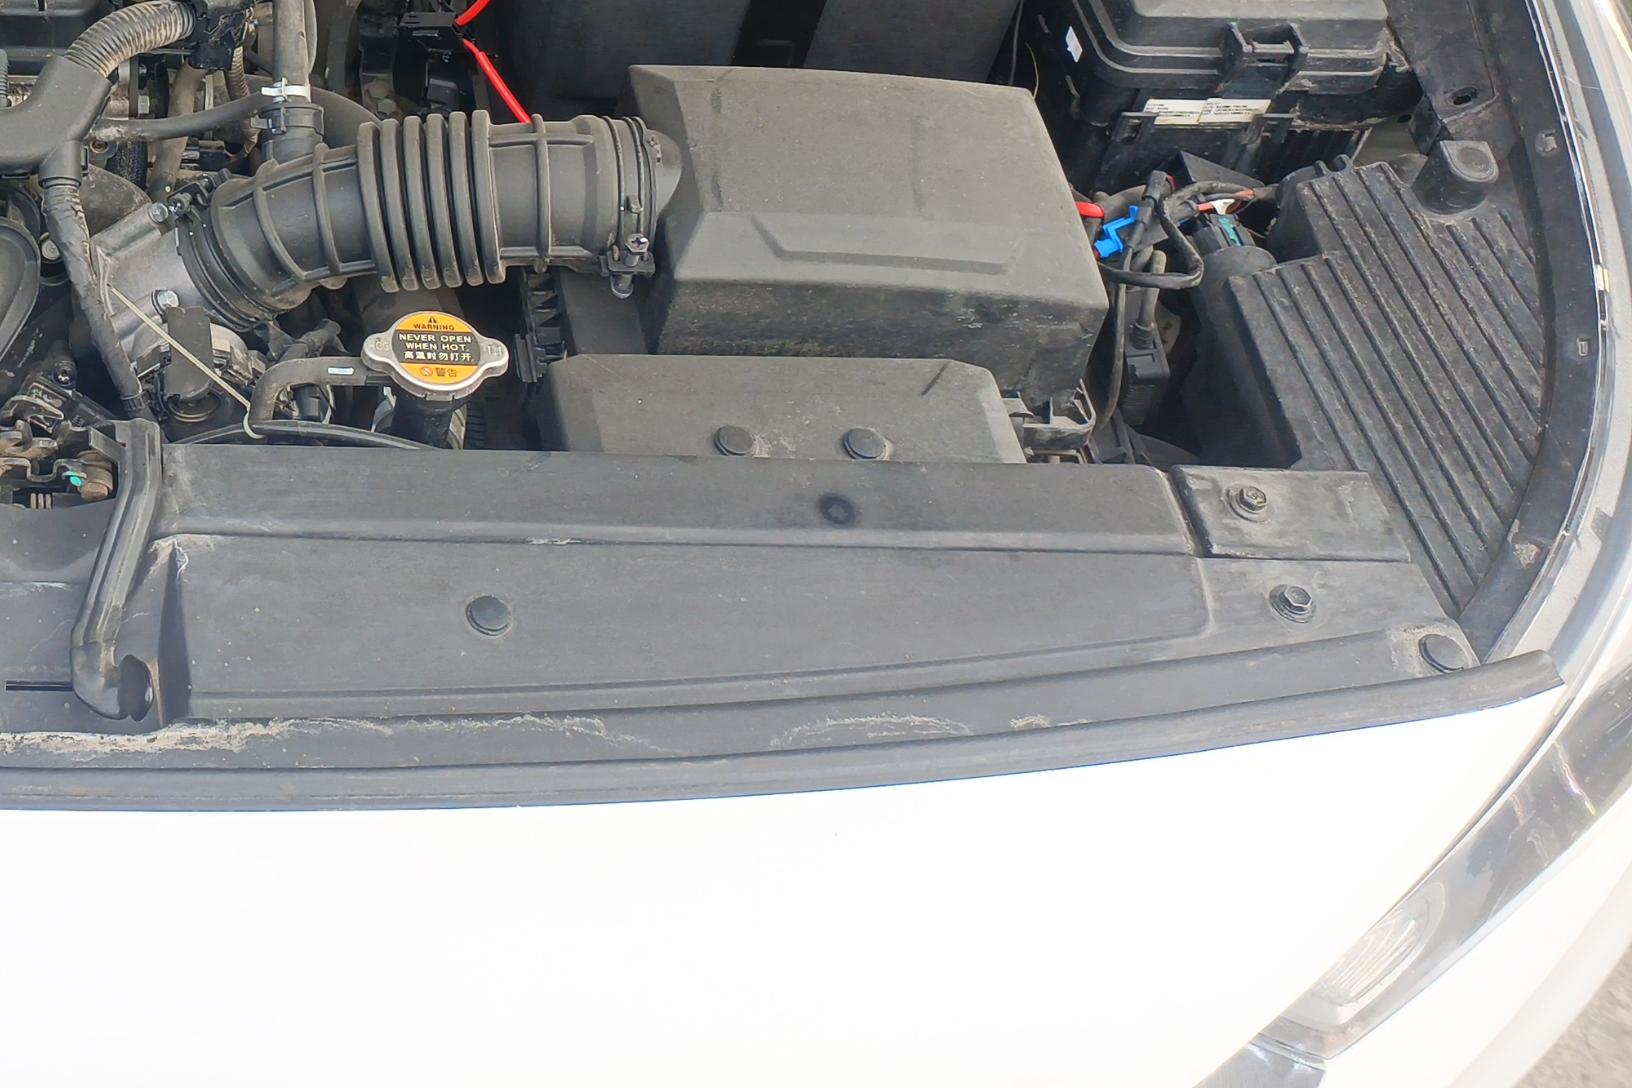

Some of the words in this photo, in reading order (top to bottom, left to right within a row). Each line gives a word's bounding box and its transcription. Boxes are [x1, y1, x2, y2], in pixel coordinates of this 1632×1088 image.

[413, 323, 455, 331] WARNING
[399, 333, 436, 342] NEVER
[440, 334, 472, 343] OPEN
[405, 342, 437, 350] WHEN
[435, 367, 457, 378] 警告
